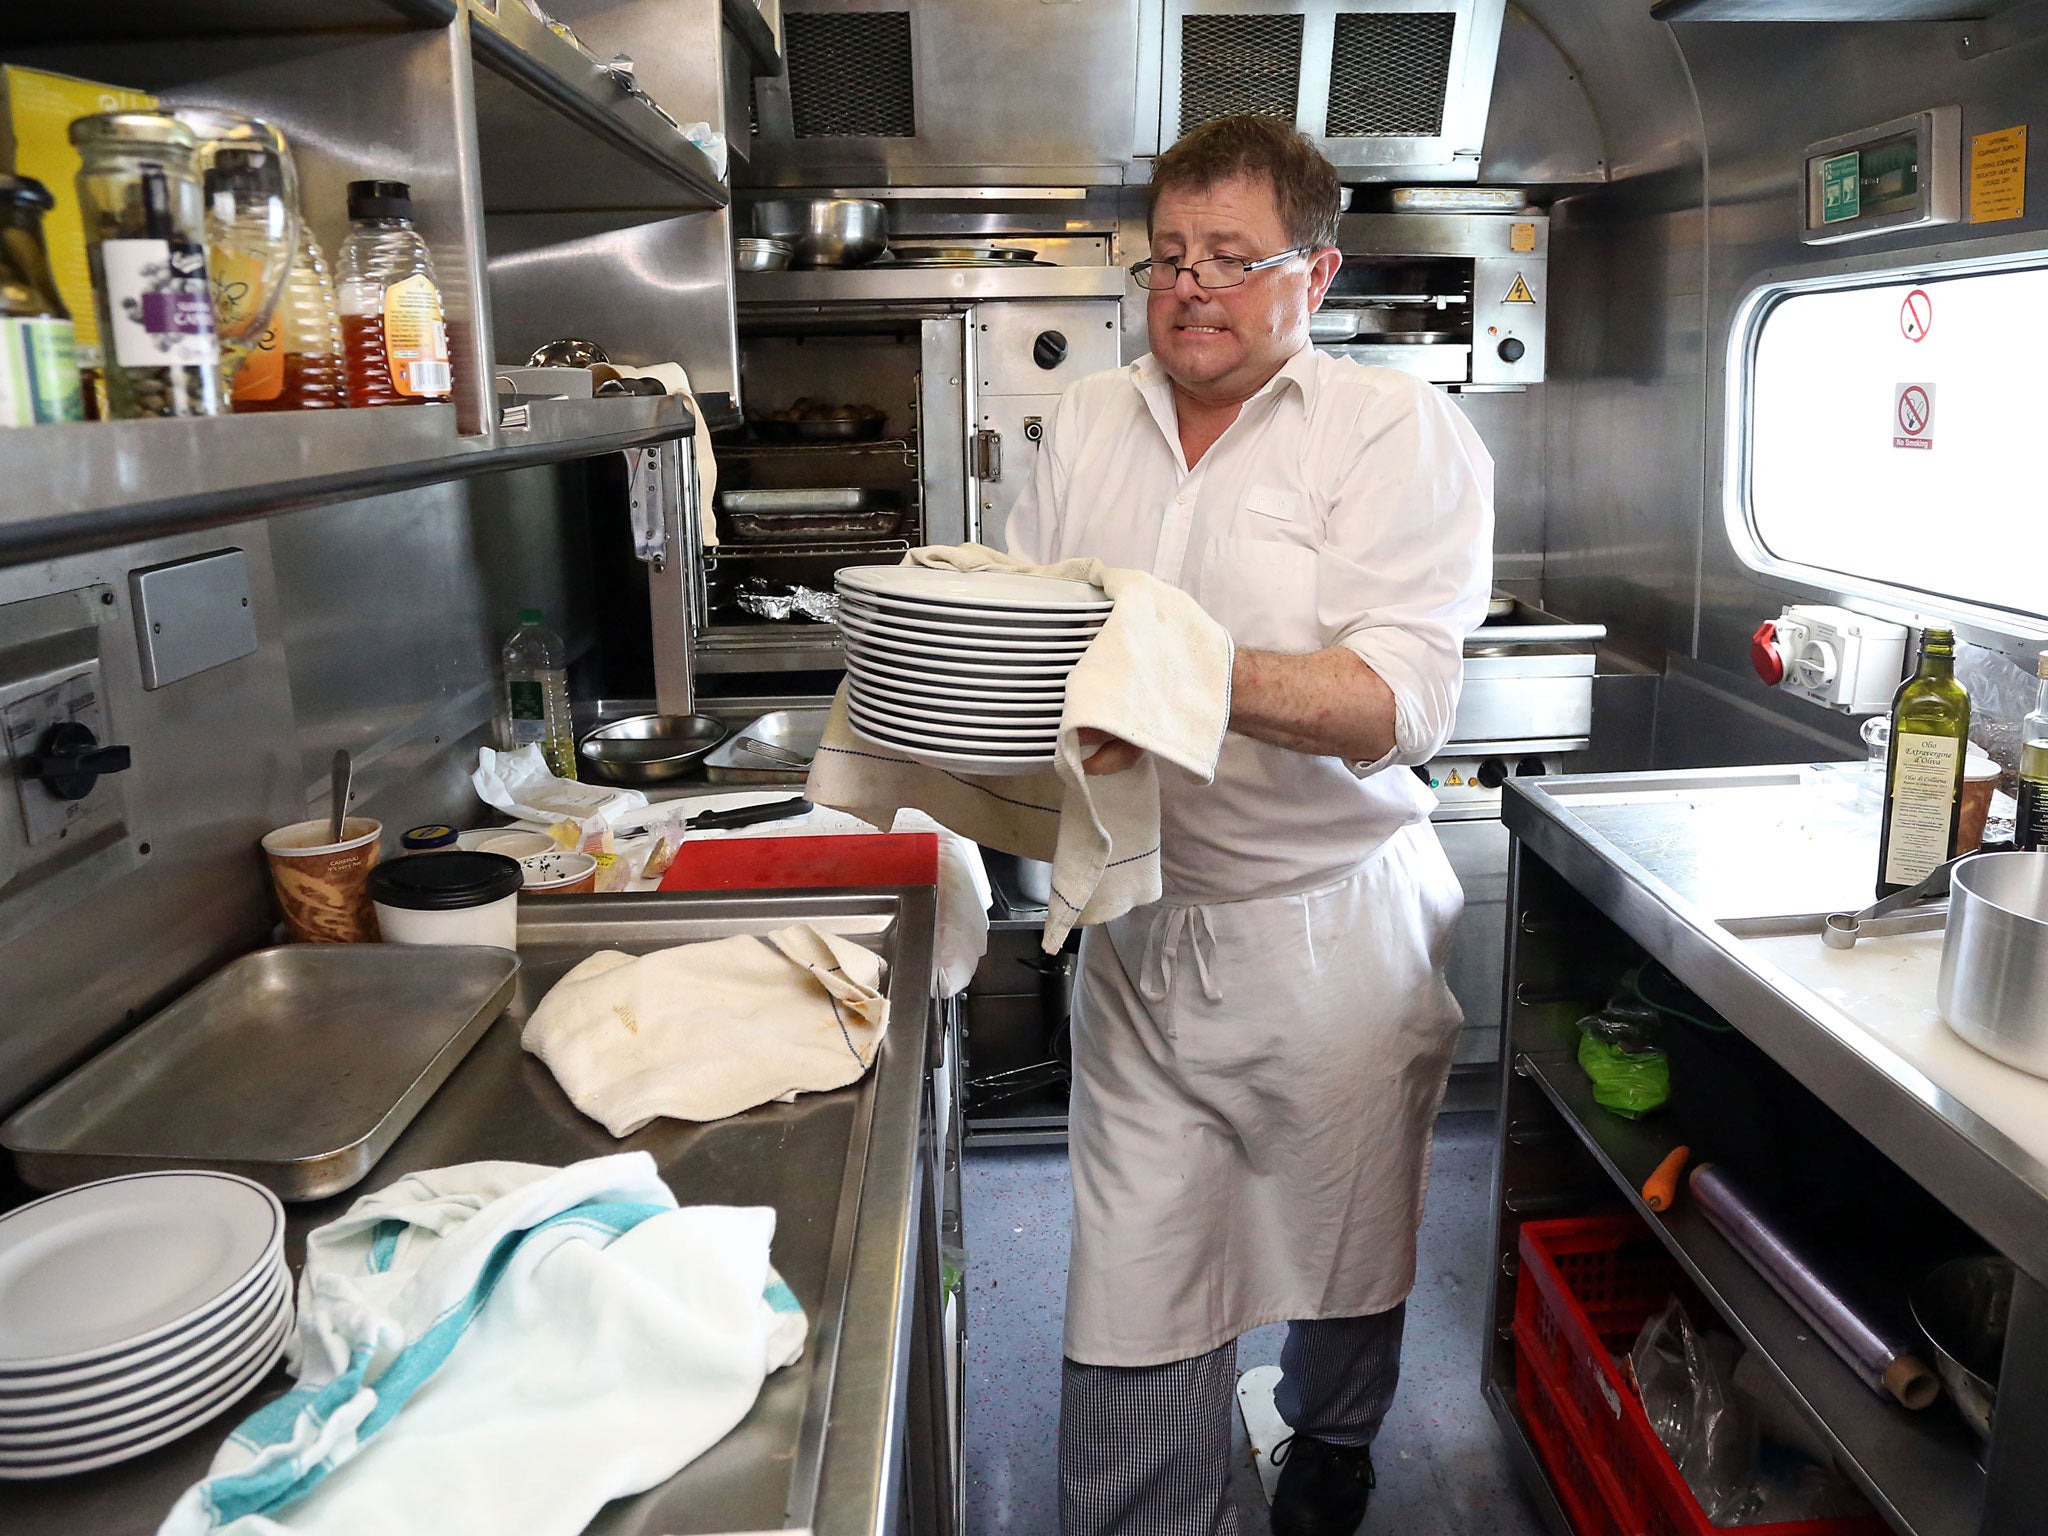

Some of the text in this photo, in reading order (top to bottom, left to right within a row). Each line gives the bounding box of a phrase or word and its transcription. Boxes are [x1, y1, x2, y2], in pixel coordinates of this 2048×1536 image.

[1896, 438, 1929, 449] No Smoking
[1921, 741, 1937, 749] Olio
[1905, 748, 1952, 759] Extravergine
[1913, 756, 1941, 765] d'Oliva
